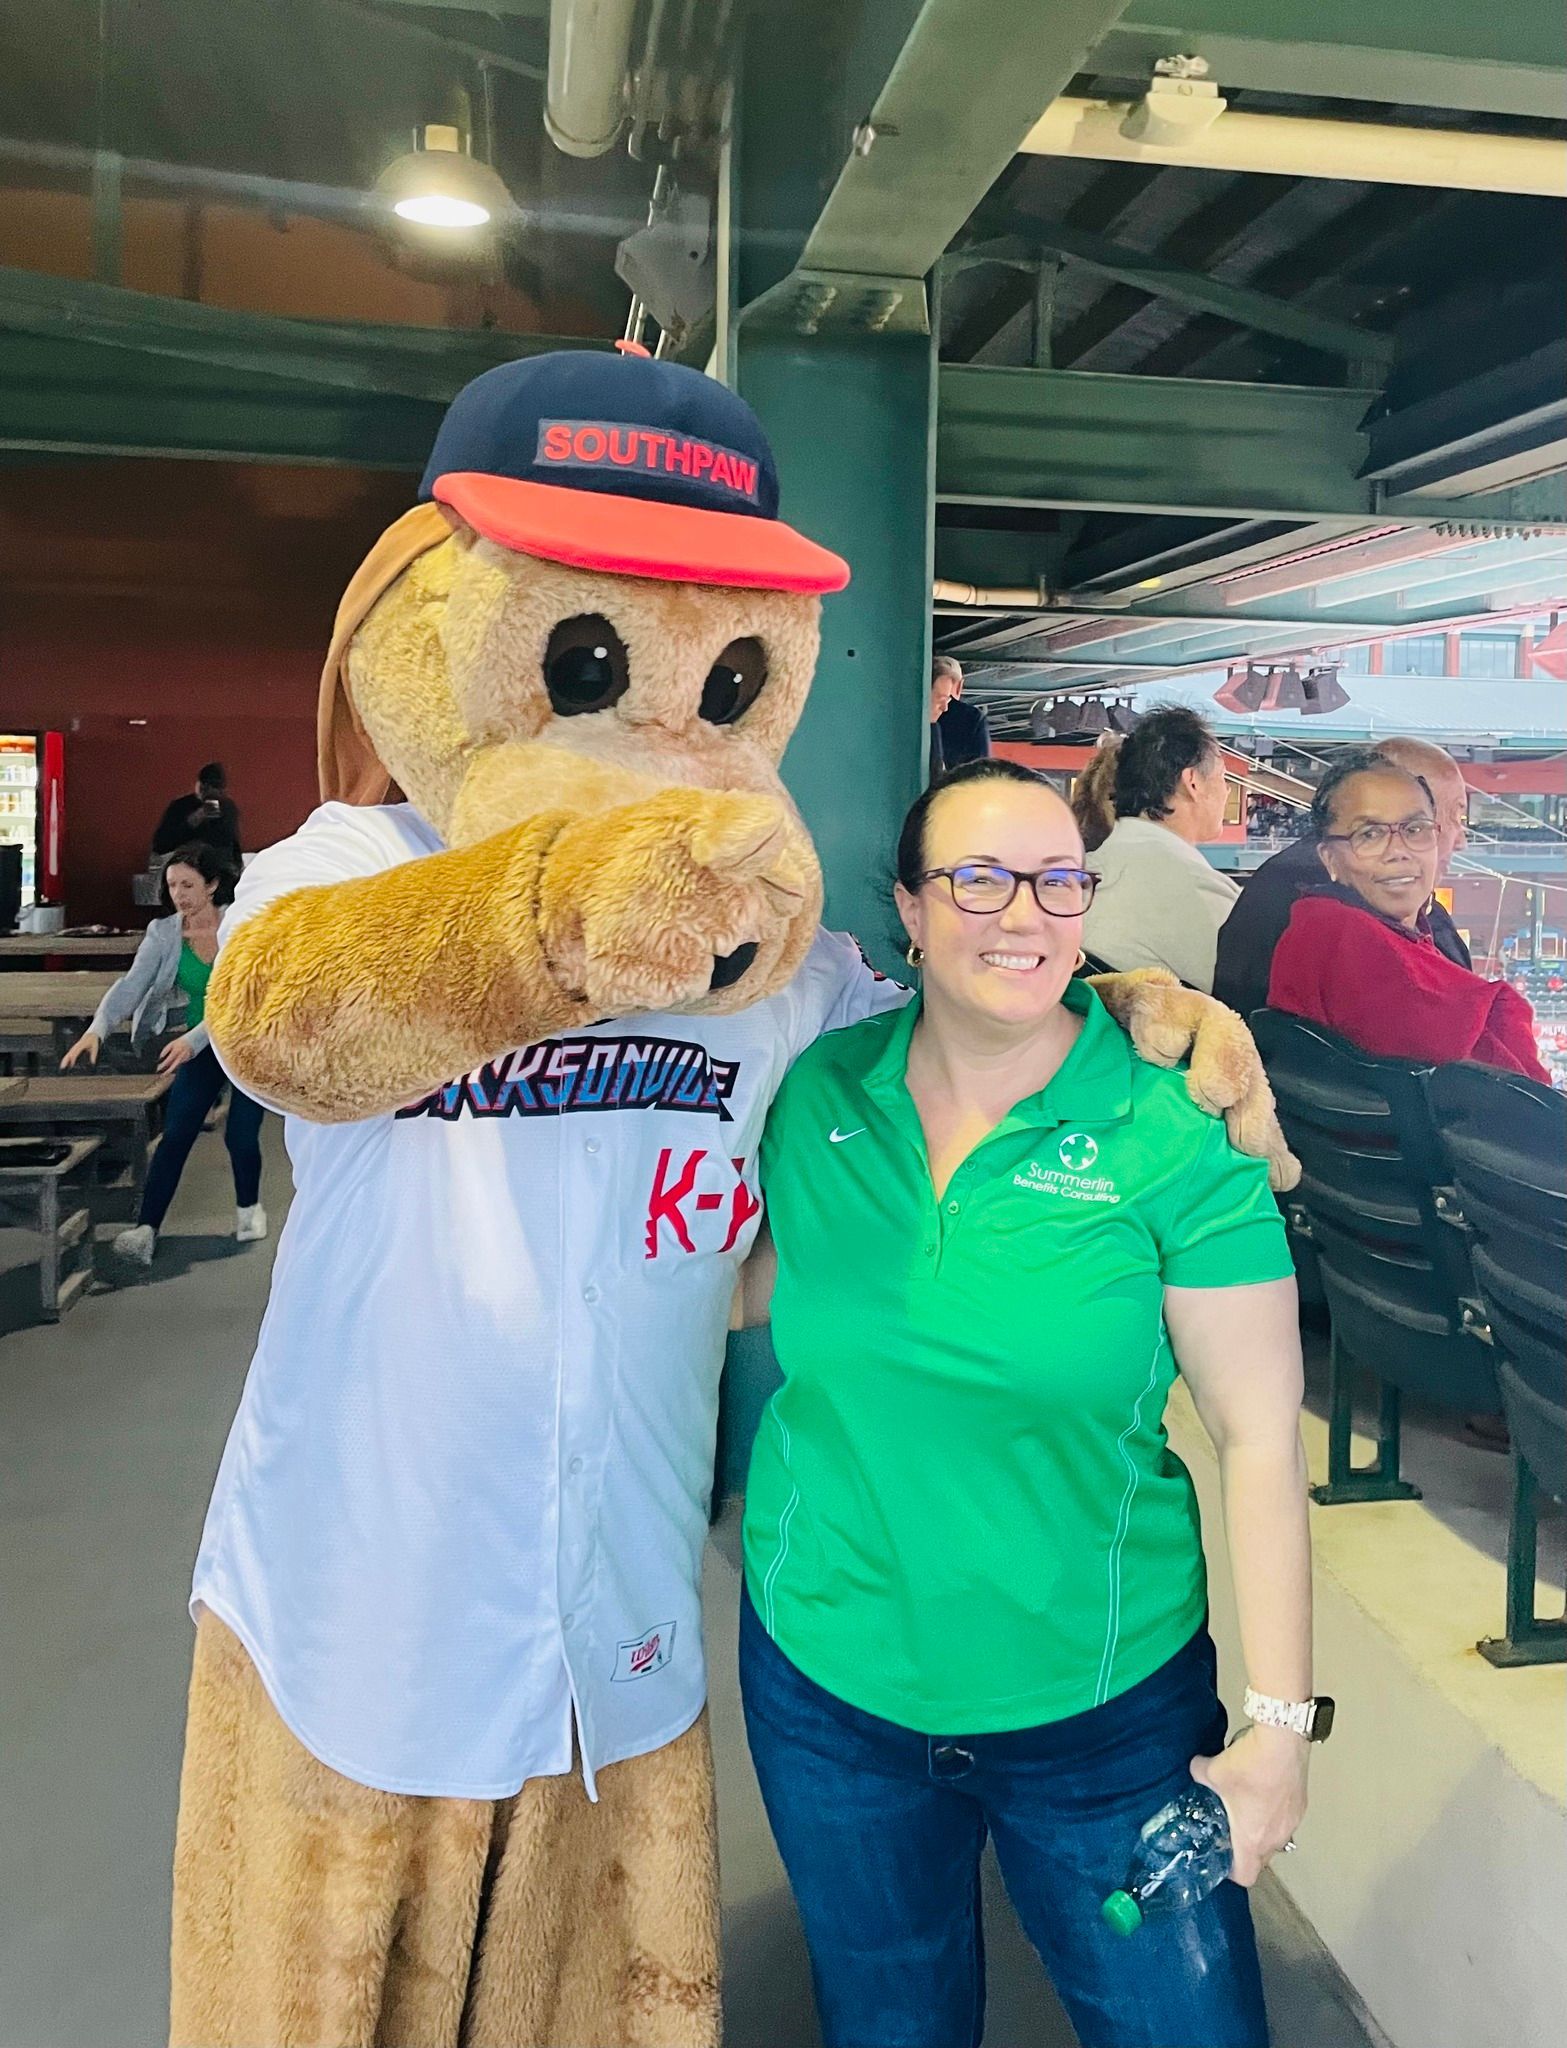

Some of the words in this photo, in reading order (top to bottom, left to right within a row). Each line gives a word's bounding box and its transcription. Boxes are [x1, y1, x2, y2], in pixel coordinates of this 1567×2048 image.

[544, 425, 757, 495] SOUTHPAW
[1012, 1174, 1058, 1194] Benefits
[1060, 1186, 1121, 1204] Consulting
[1028, 1162, 1114, 1192] Summerlin
